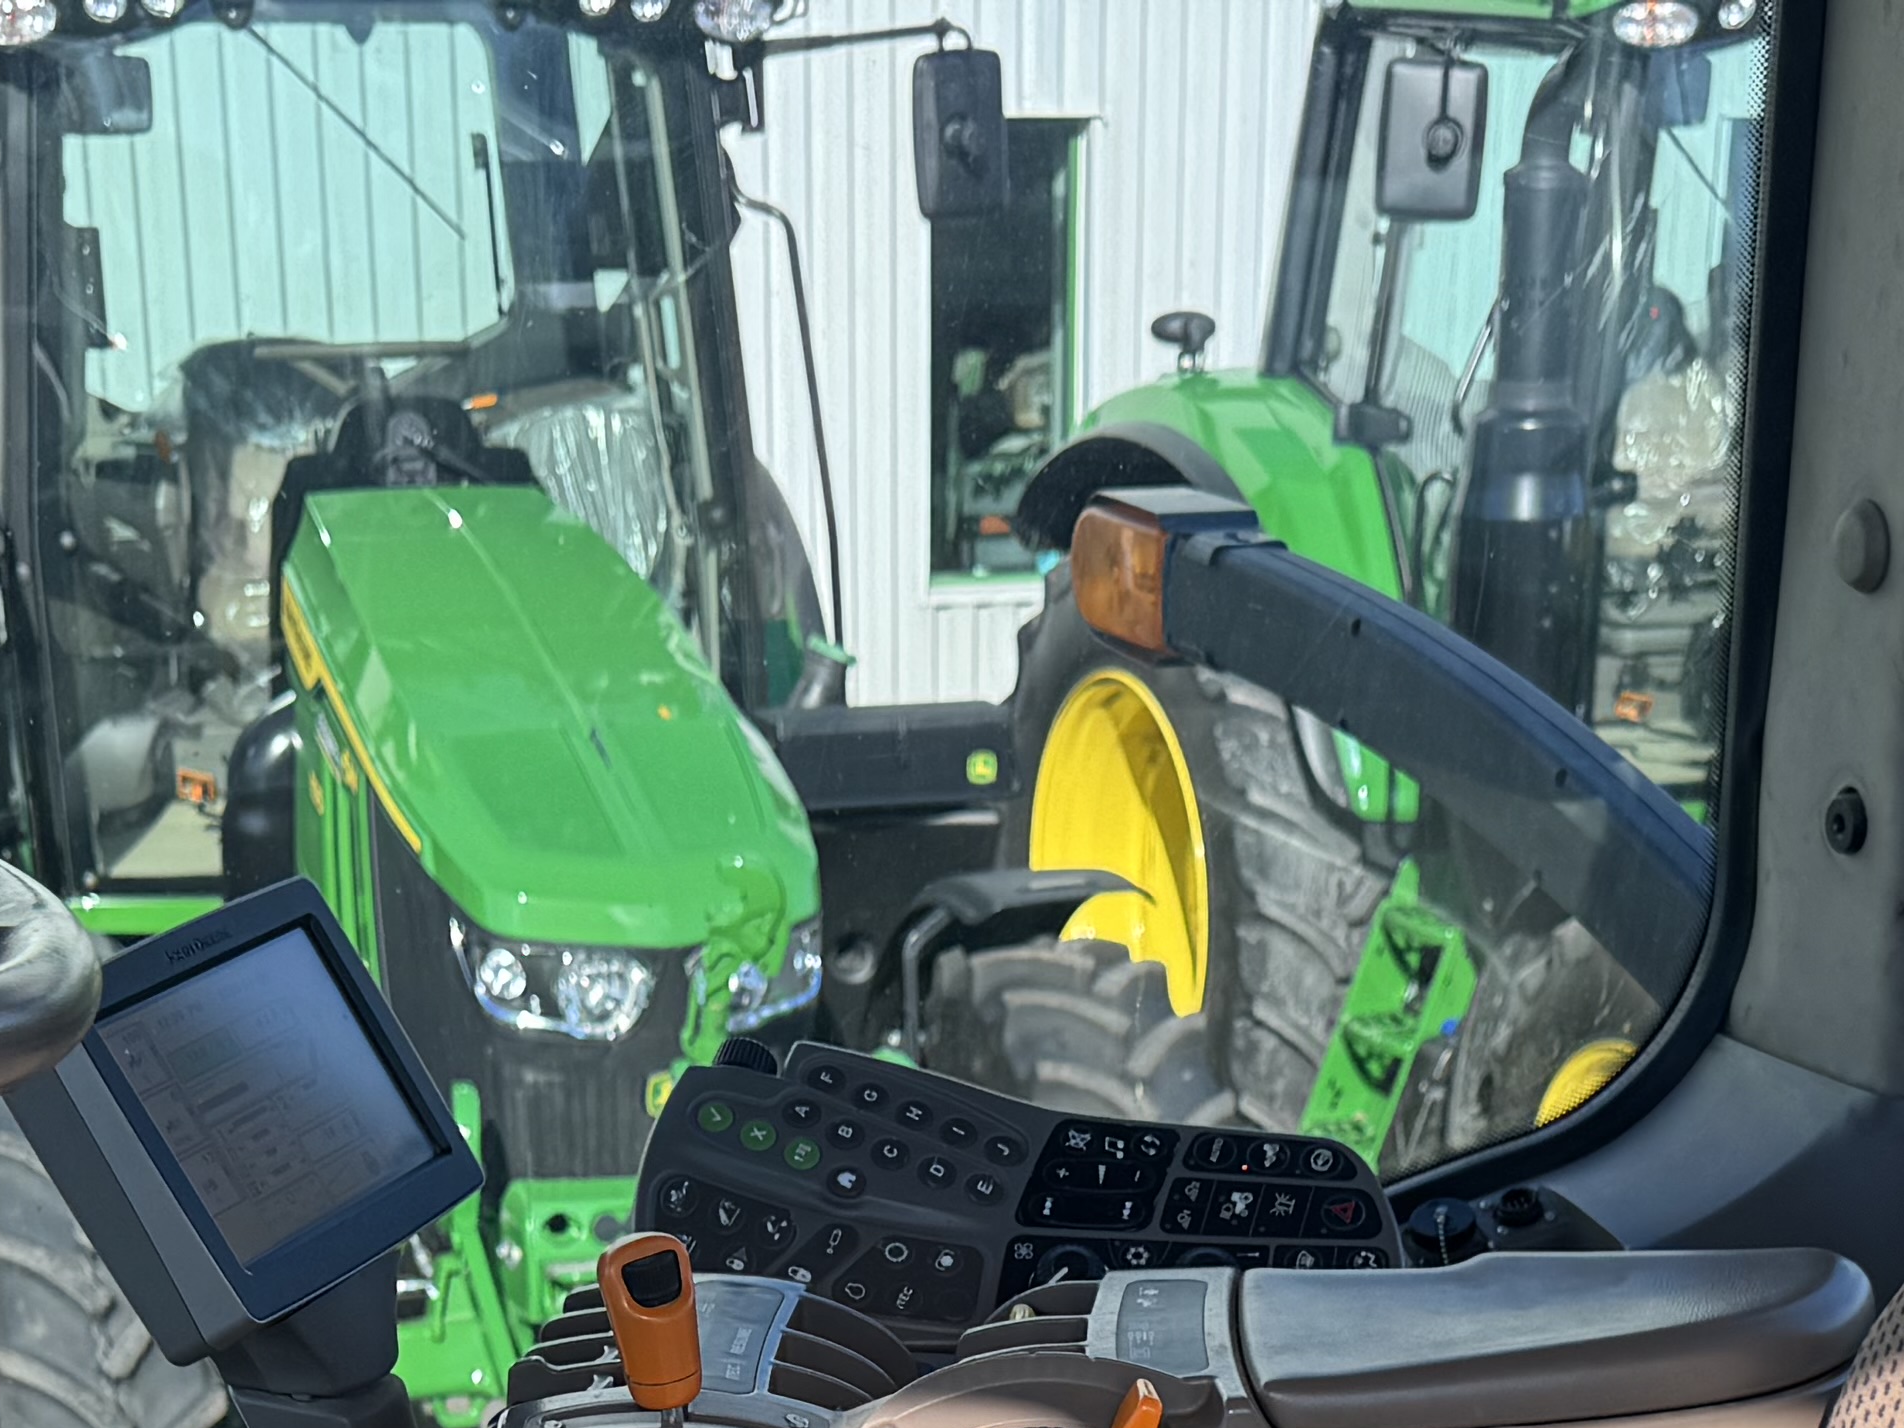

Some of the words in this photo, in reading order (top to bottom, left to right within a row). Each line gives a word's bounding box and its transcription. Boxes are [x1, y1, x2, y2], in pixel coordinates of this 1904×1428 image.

[820, 1071, 833, 1084] F
[863, 1089, 878, 1102] G
[795, 1105, 810, 1118] A
[905, 1105, 923, 1121] H
[838, 1125, 853, 1139] B
[883, 1144, 898, 1158] C
[997, 1142, 1010, 1156] J
[929, 1164, 945, 1177] D
[976, 1179, 993, 1195] E
